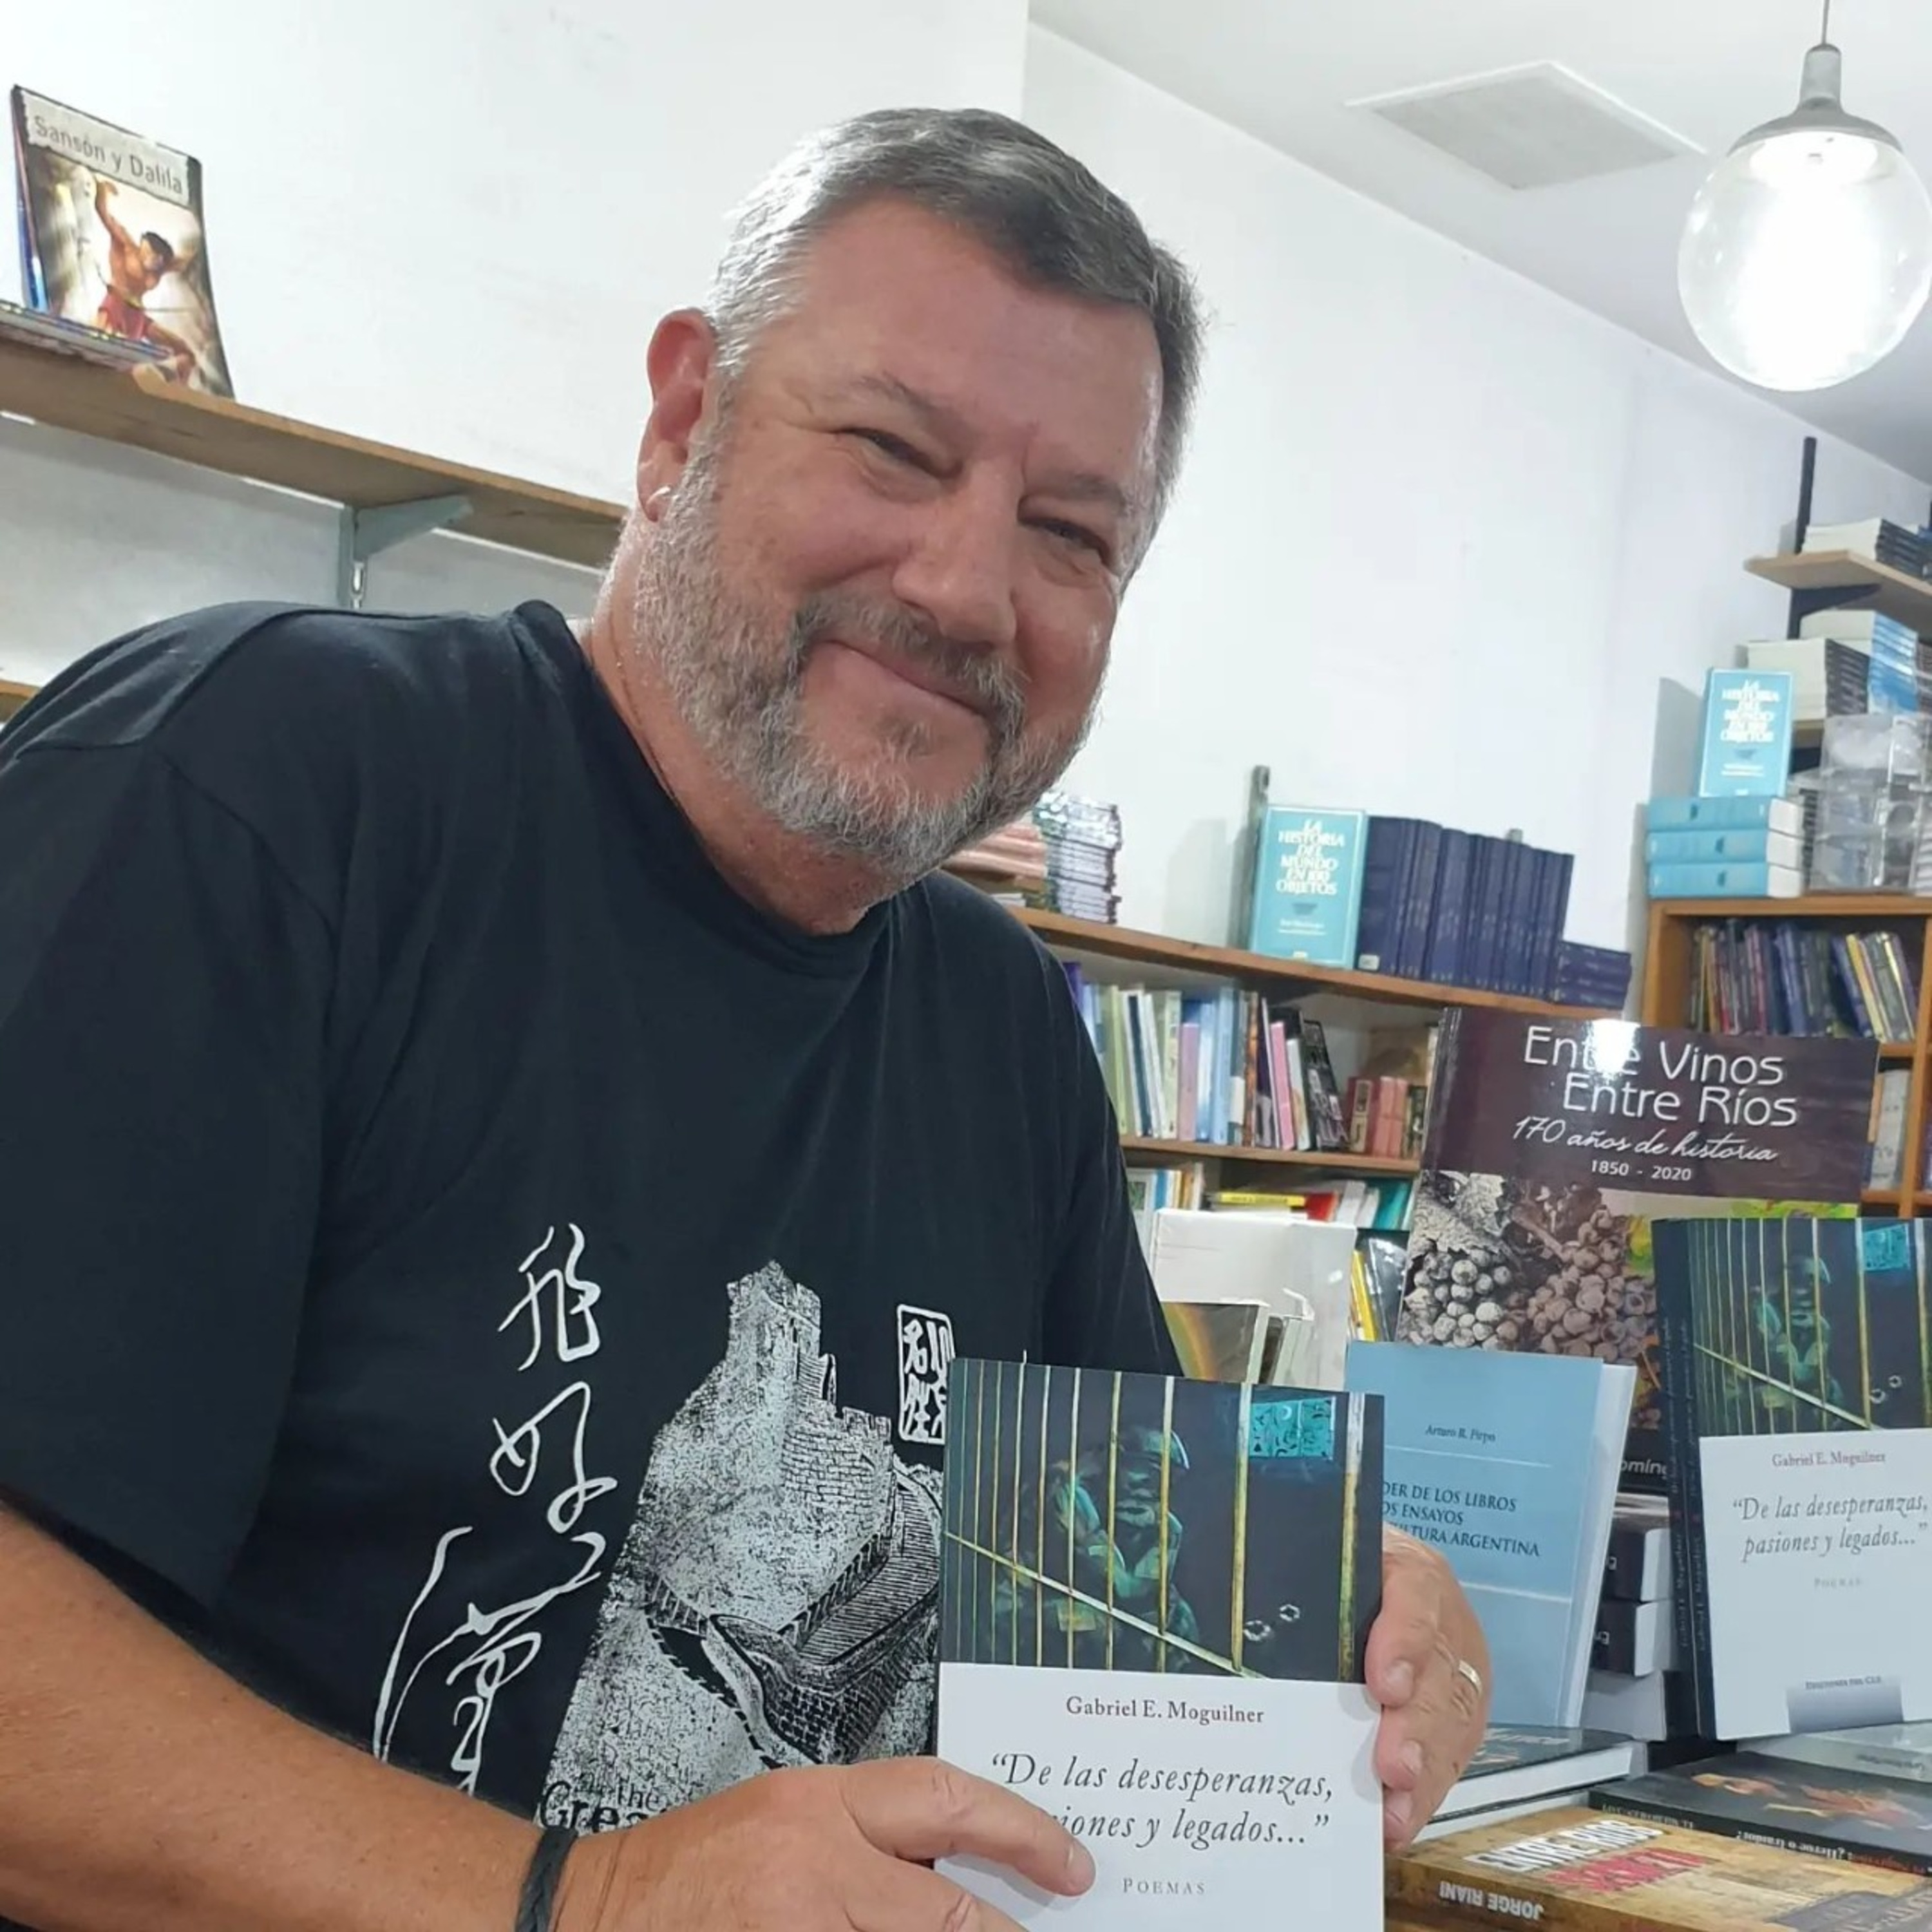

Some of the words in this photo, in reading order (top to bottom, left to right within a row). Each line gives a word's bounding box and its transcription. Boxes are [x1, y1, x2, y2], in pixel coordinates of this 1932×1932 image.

[34, 115, 106, 163] Sansón
[111, 152, 122, 173] y
[129, 155, 183, 194] Dalila
[1278, 830, 1345, 848] HISTORIA
[1303, 819, 1321, 831] LA
[1280, 855, 1339, 871] MUNDO
[1276, 880, 1337, 895] OBJETOS
[1524, 1025, 1640, 1075] Ente
[1658, 1041, 1786, 1085] Vinos
[1564, 1072, 1681, 1122] Entre
[1699, 1085, 1799, 1127] Ríos
[1512, 1115, 1566, 1144] 170
[1567, 1130, 1632, 1151] años
[1634, 1128, 1669, 1155] de
[1671, 1130, 1778, 1161] historia
[1591, 1160, 1630, 1177] 1850
[1651, 1165, 1692, 1181] 2020
[1772, 1452, 1814, 1466] Gabriel
[1830, 1451, 1886, 1467] Moguilner
[1383, 1481, 1408, 1498] DER
[1412, 1485, 1432, 1500] DE
[1435, 1488, 1462, 1504] LOS
[1464, 1492, 1517, 1512] LIBROS
[1775, 1495, 1800, 1519] las
[1806, 1494, 1928, 1522] desesperanzas,
[1383, 1501, 1397, 1516] OS
[1402, 1504, 1464, 1526] ENSAYOS
[1450, 1532, 1540, 1557] ARGENTINA
[1741, 1531, 1819, 1564] pasiones
[1819, 1536, 1832, 1557] y
[1066, 1696, 1137, 1717] Gabriel
[1142, 1701, 1162, 1718] E.
[1168, 1701, 1264, 1725] Moguilner
[992, 1754, 1051, 1786] “De
[1063, 1756, 1107, 1788] las
[1118, 1759, 1333, 1805] desesperanzas,
[540, 1780, 667, 1834] Gre
[1052, 1805, 1136, 1838] iones
[1135, 1817, 1160, 1848] y
[1122, 1878, 1205, 1895] POEMAS
[1439, 1880, 1483, 1908] RIANI
[1487, 1892, 1544, 1920] JORGE
